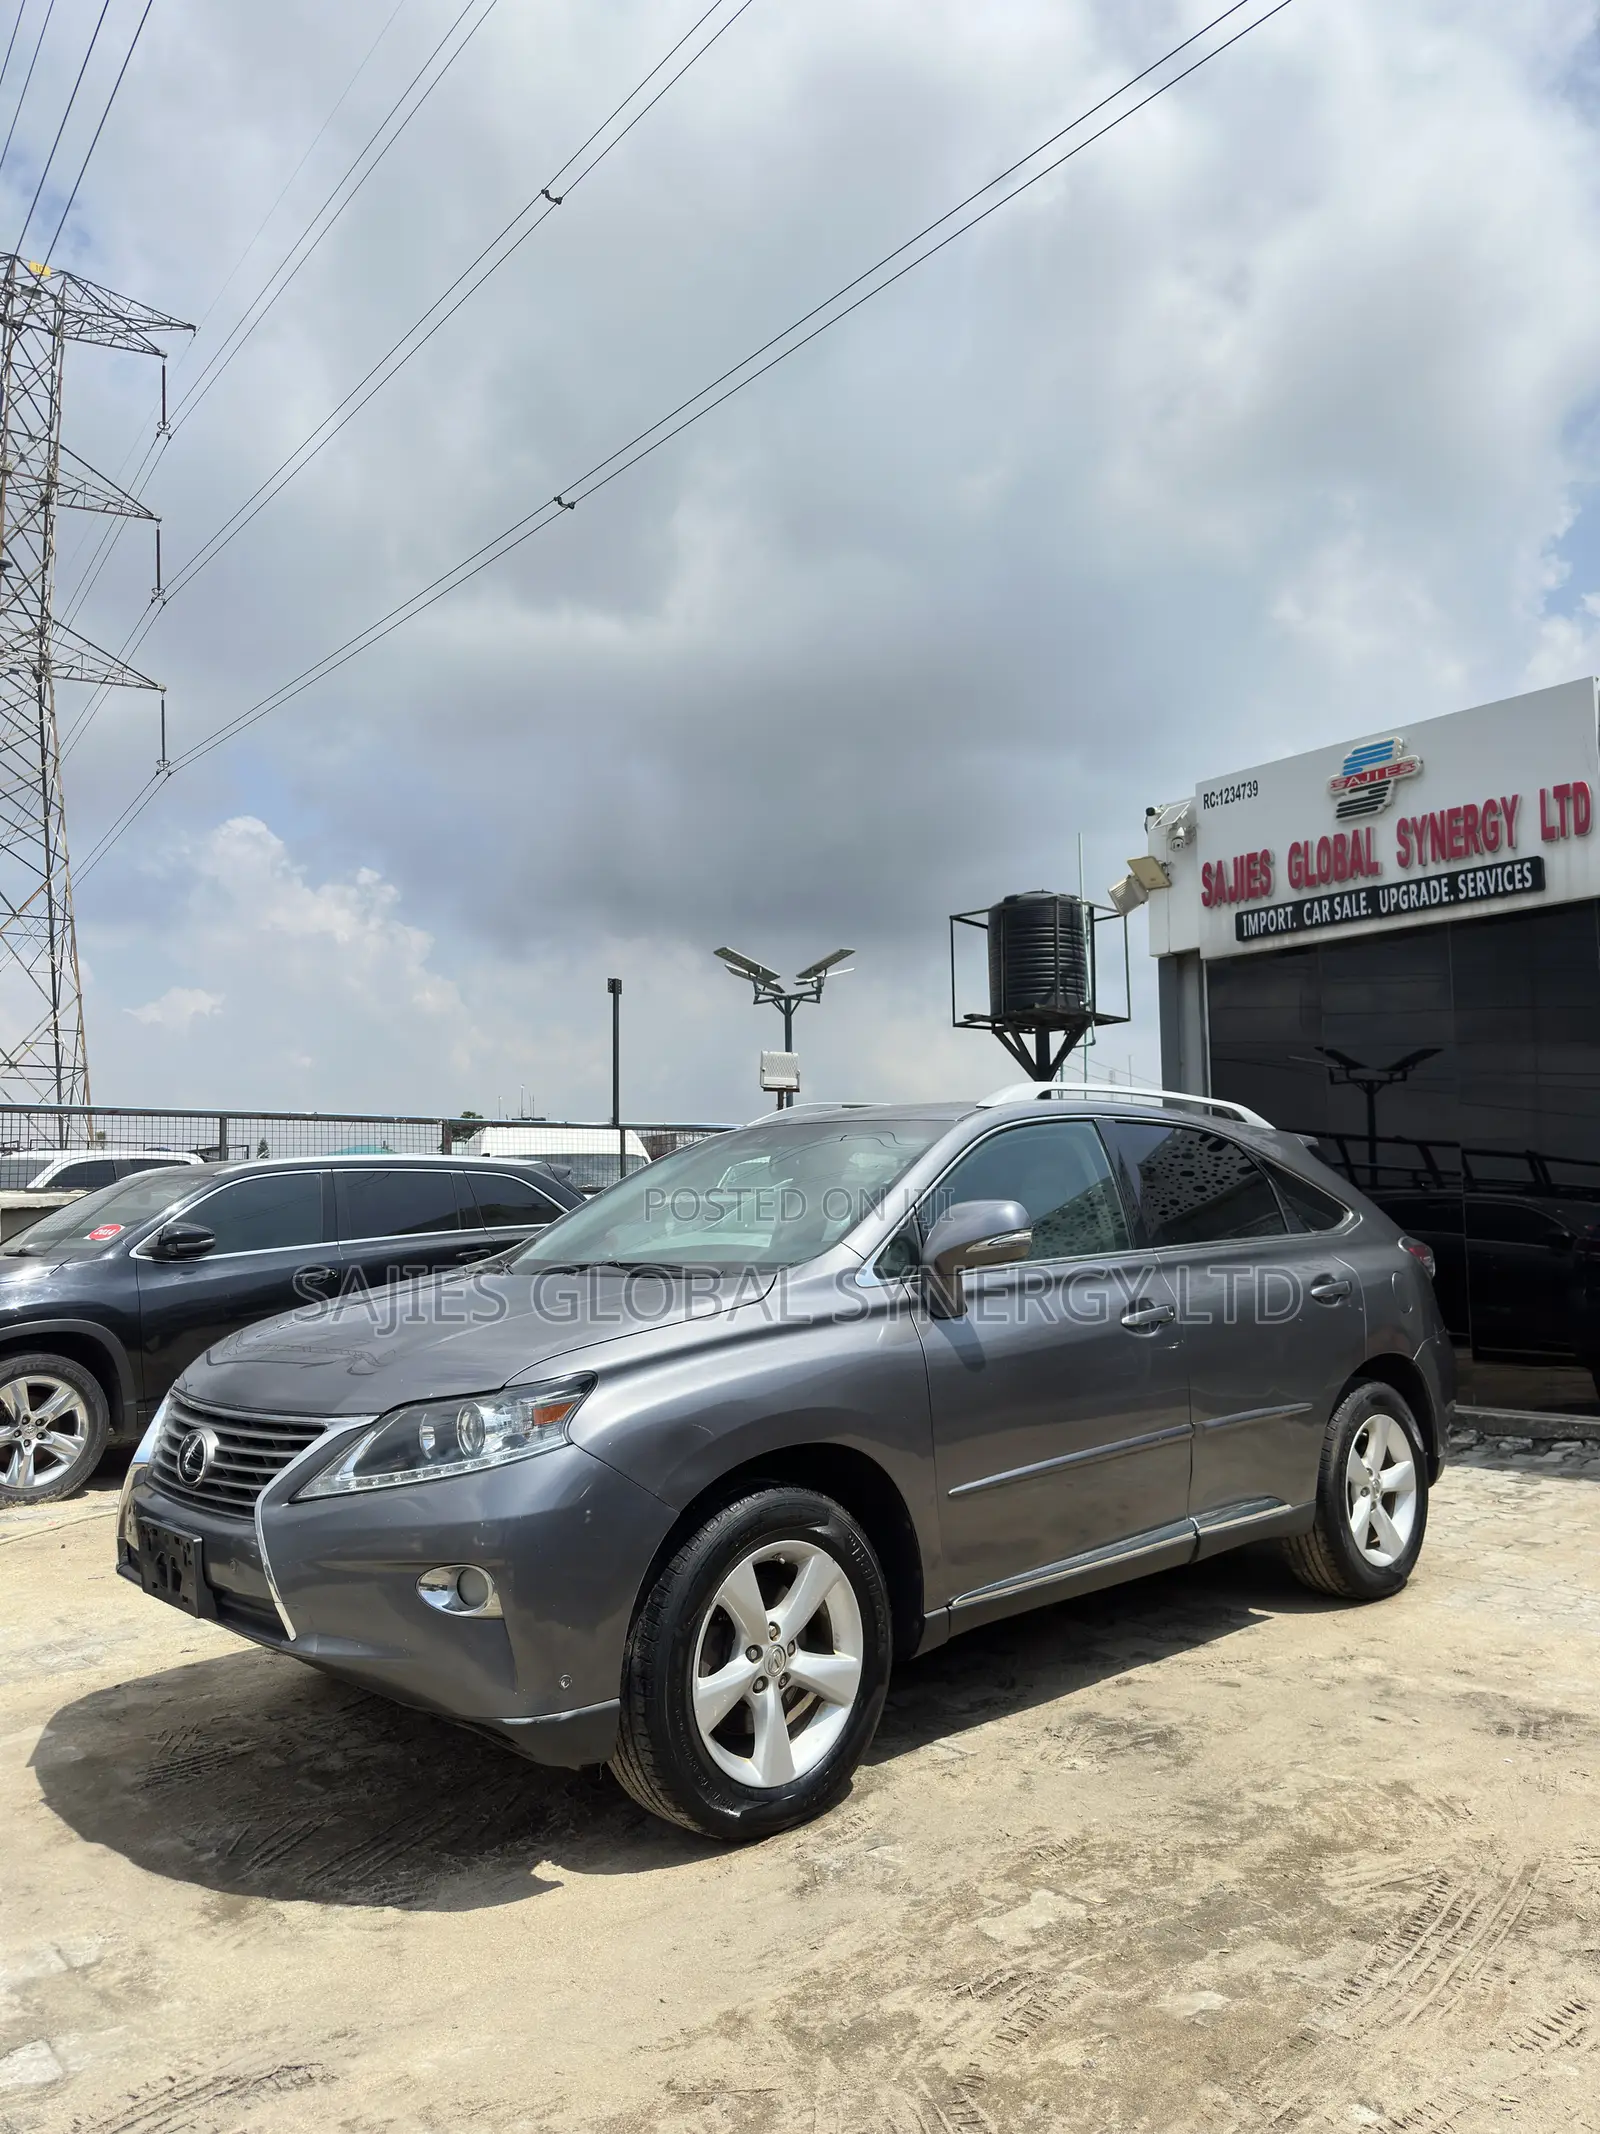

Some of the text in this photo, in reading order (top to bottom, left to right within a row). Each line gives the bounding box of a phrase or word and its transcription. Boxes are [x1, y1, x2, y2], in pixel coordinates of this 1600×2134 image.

[1203, 780, 1259, 810] RC:1234739
[1329, 760, 1417, 791] SAJIES
[1201, 781, 1591, 907] SAJIES GLOBAL SYNERGY LTD
[1243, 862, 1533, 937] IMPORT. CAR SALE. UPGRADE. SERVICES
